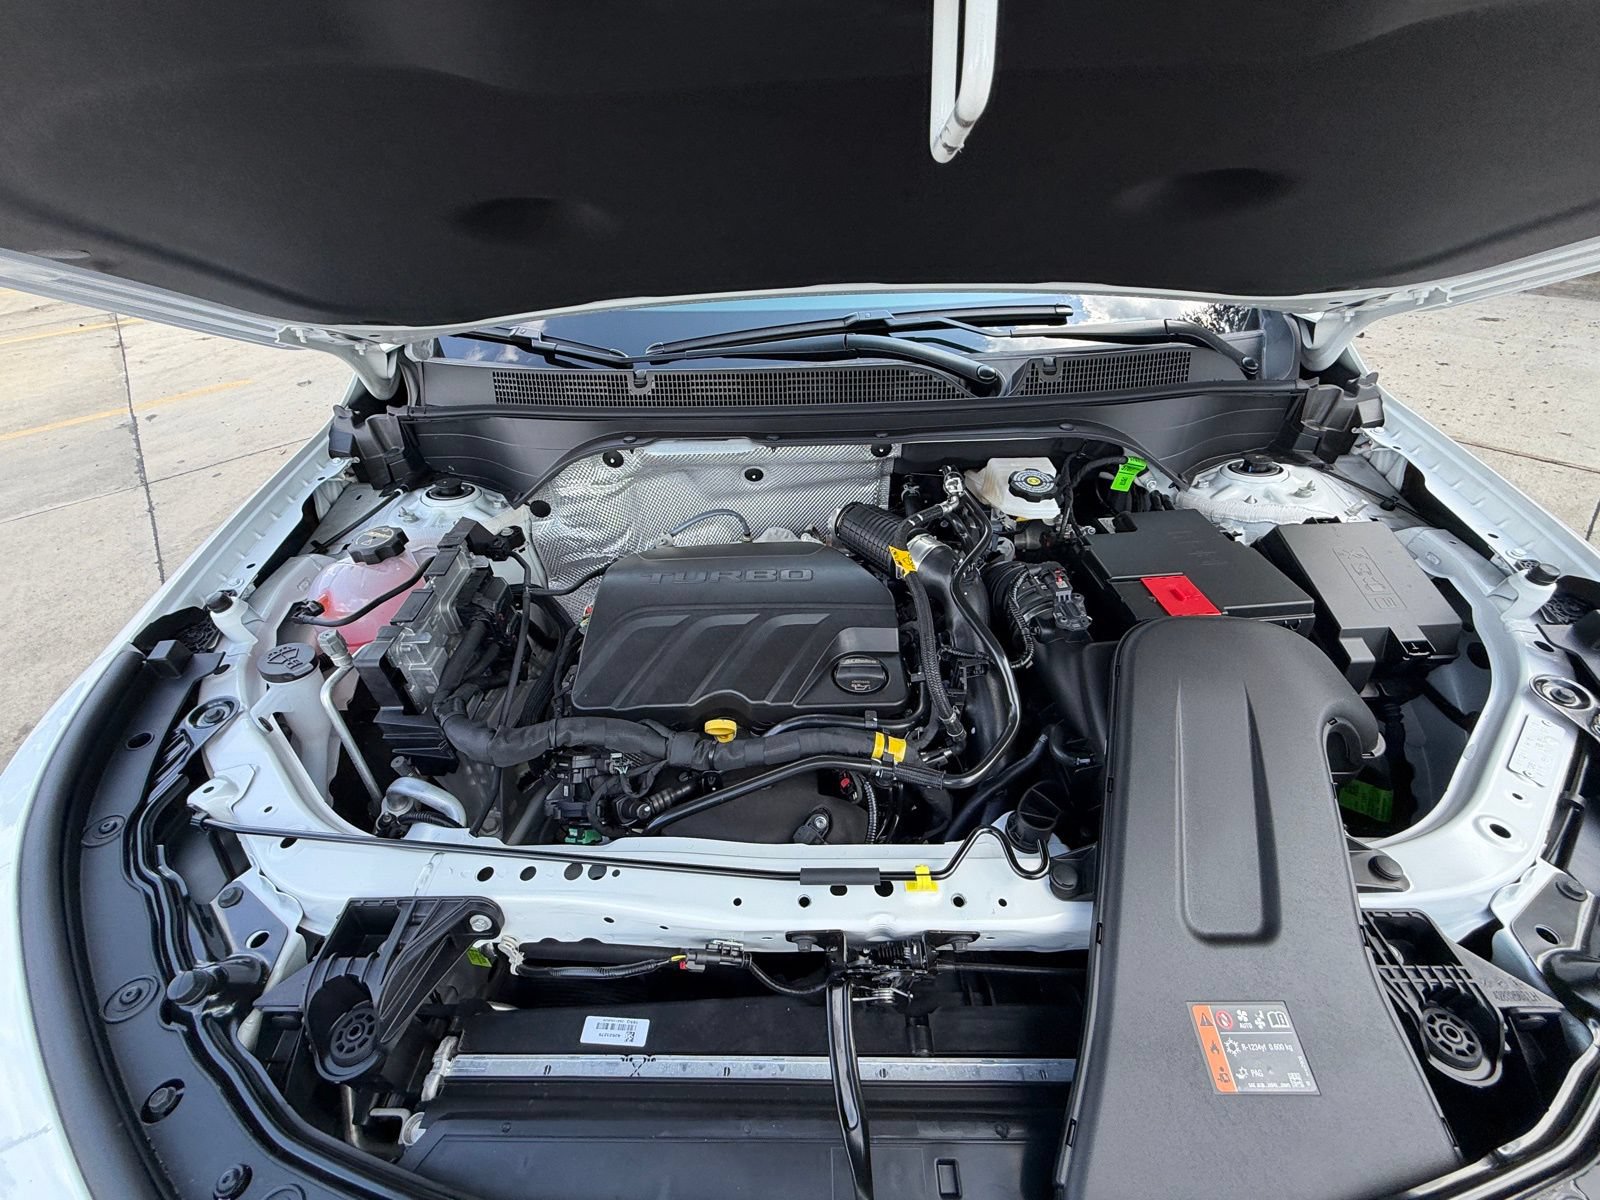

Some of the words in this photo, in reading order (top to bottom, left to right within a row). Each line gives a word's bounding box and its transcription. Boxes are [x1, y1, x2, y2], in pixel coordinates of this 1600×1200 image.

[640, 569, 814, 585] TURBO
[1284, 1043, 1293, 1052] kg
[1250, 1069, 1264, 1078] PAG
